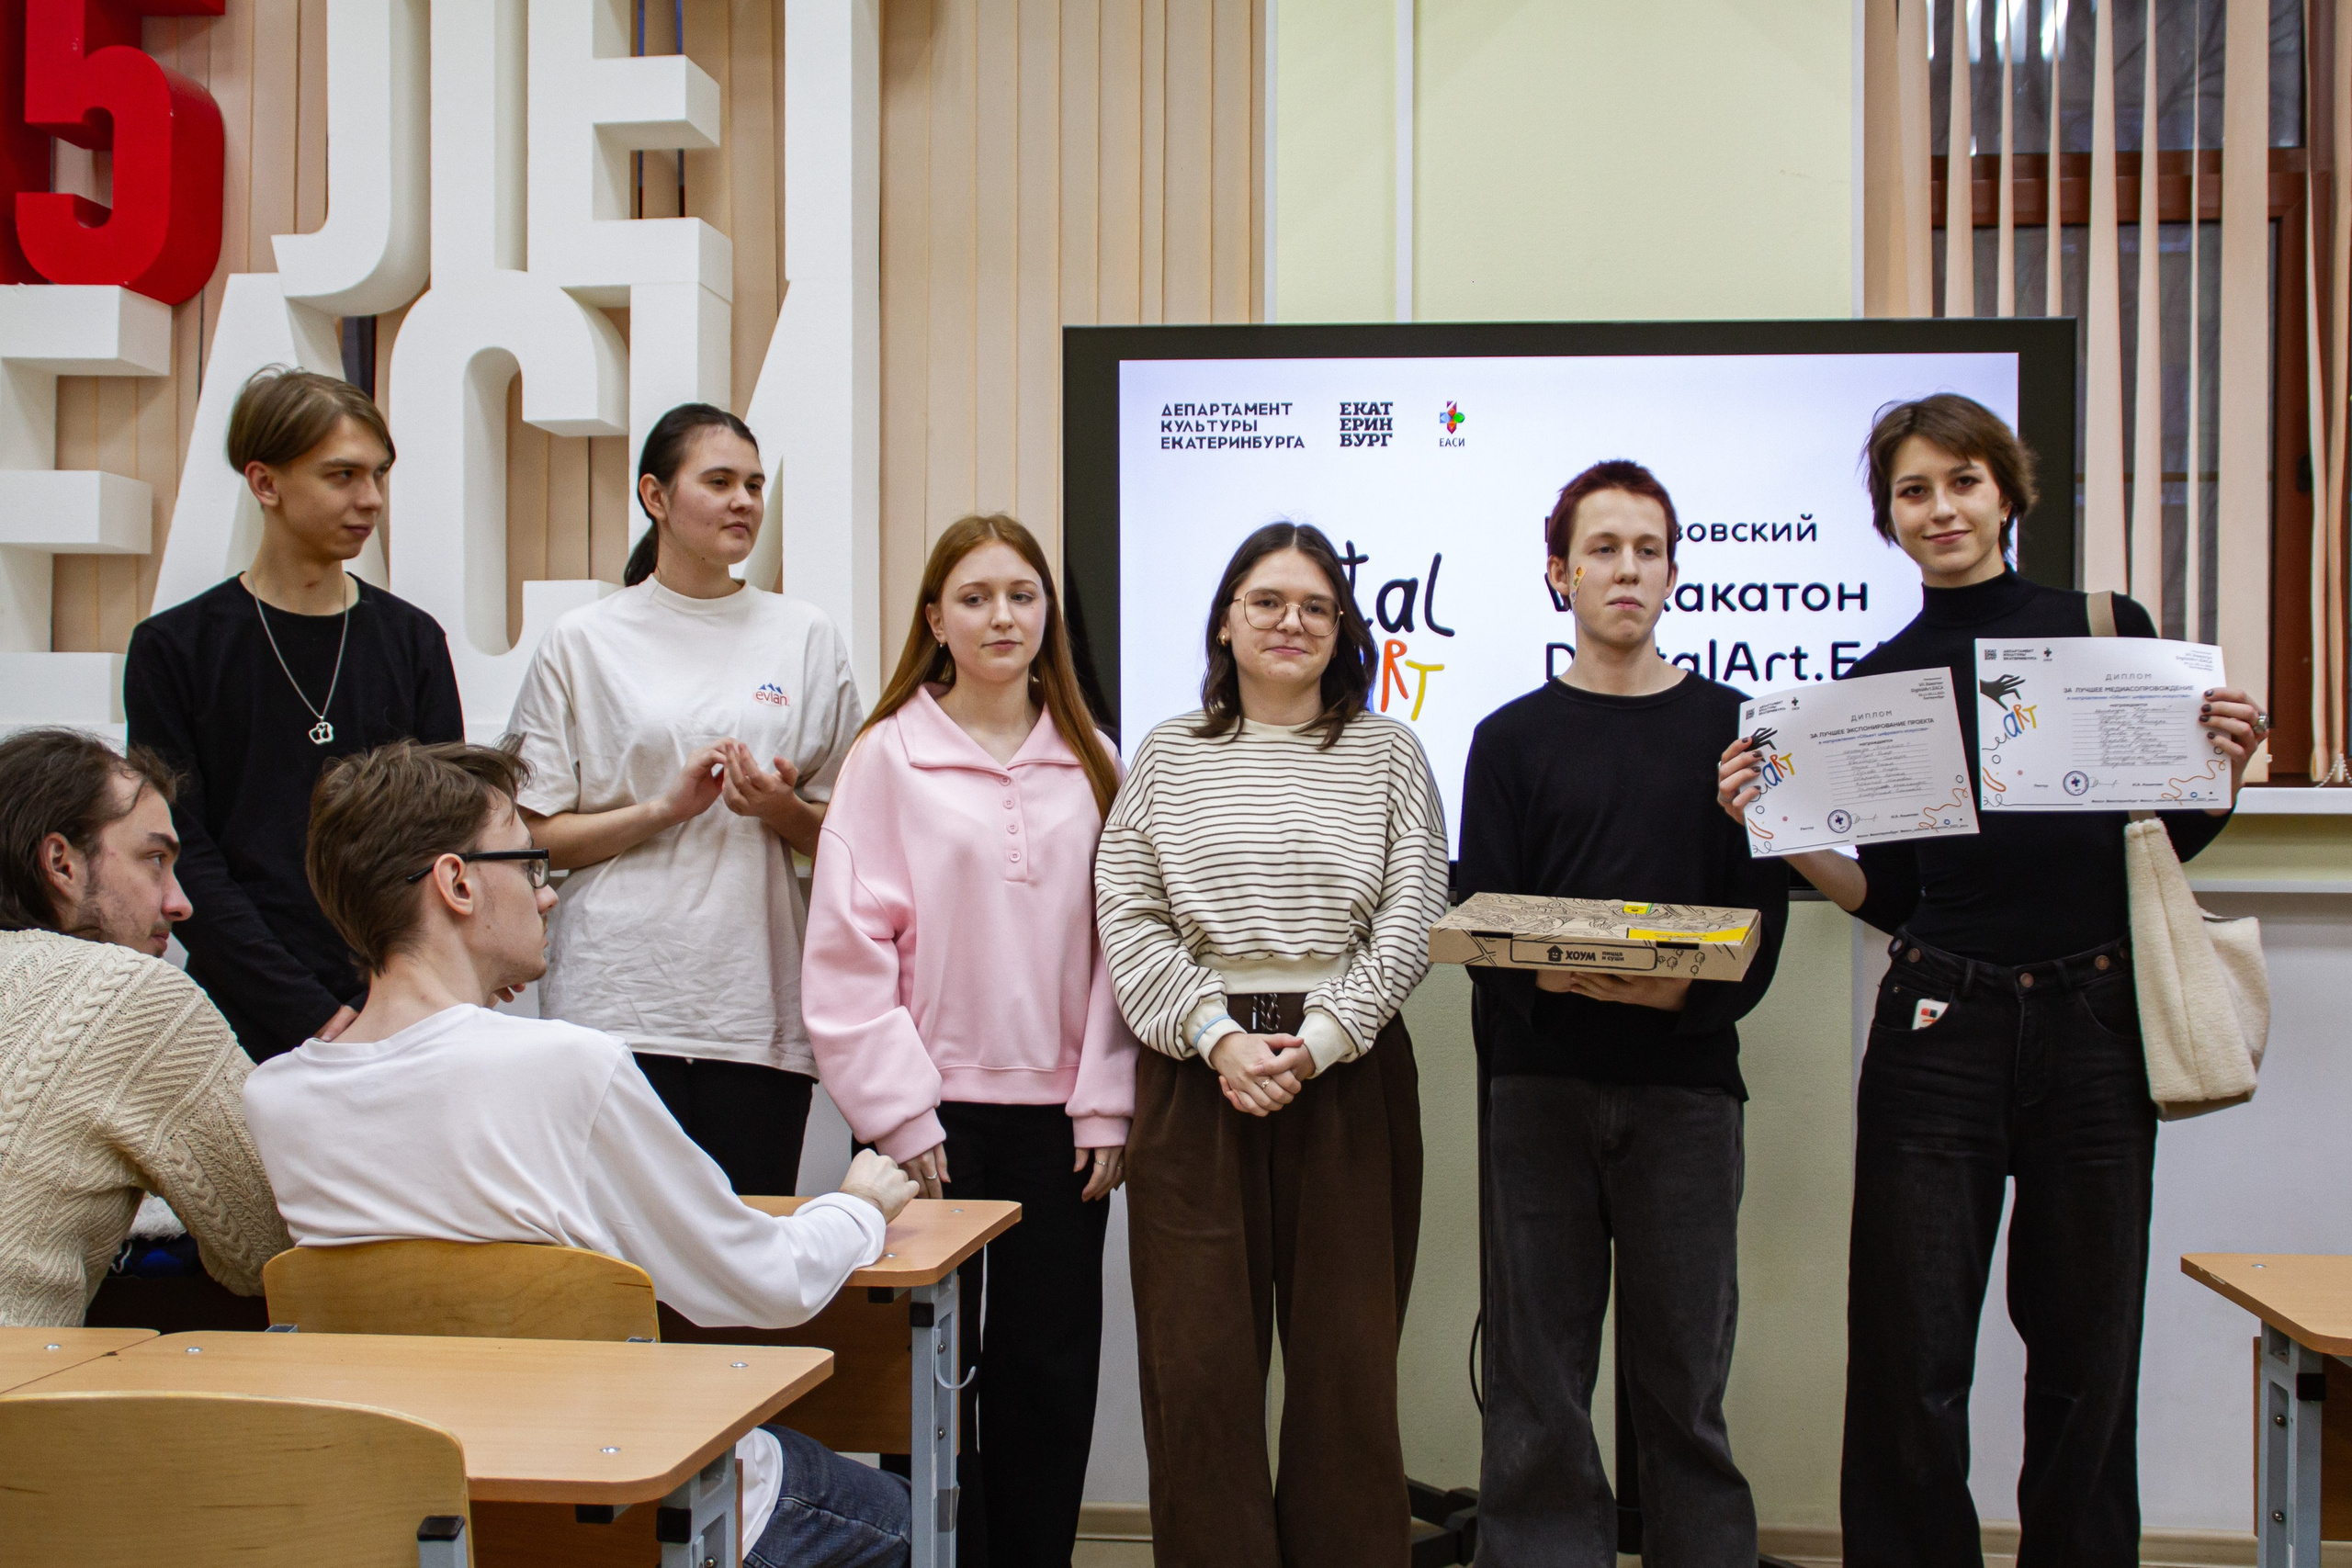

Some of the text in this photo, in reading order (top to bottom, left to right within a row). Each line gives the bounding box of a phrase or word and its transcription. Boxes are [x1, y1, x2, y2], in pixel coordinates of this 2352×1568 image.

[1160, 402, 1294, 416] ДЕПАРТАМЕНТ
[1340, 401, 1393, 415] ЕКАТ
[1160, 419, 1258, 433] КУЛЬТУРЫ
[1340, 417, 1393, 431] ЕРИН
[1160, 435, 1306, 449] ЕКАТЕРИНБУРГА
[1340, 433, 1393, 447] БУРГ
[1439, 437, 1465, 447] ЕАСИ
[1664, 582, 1868, 613] акатон
[1850, 710, 1893, 723] ДИПЛОМ
[1819, 729, 1845, 738] ЛУЧШЕЕ
[1847, 720, 1905, 733] ЭКСПОНИРОВАНИЕ
[1907, 717, 1935, 726] ПРОЕКТА
[1566, 950, 1596, 962] ХОУМ
